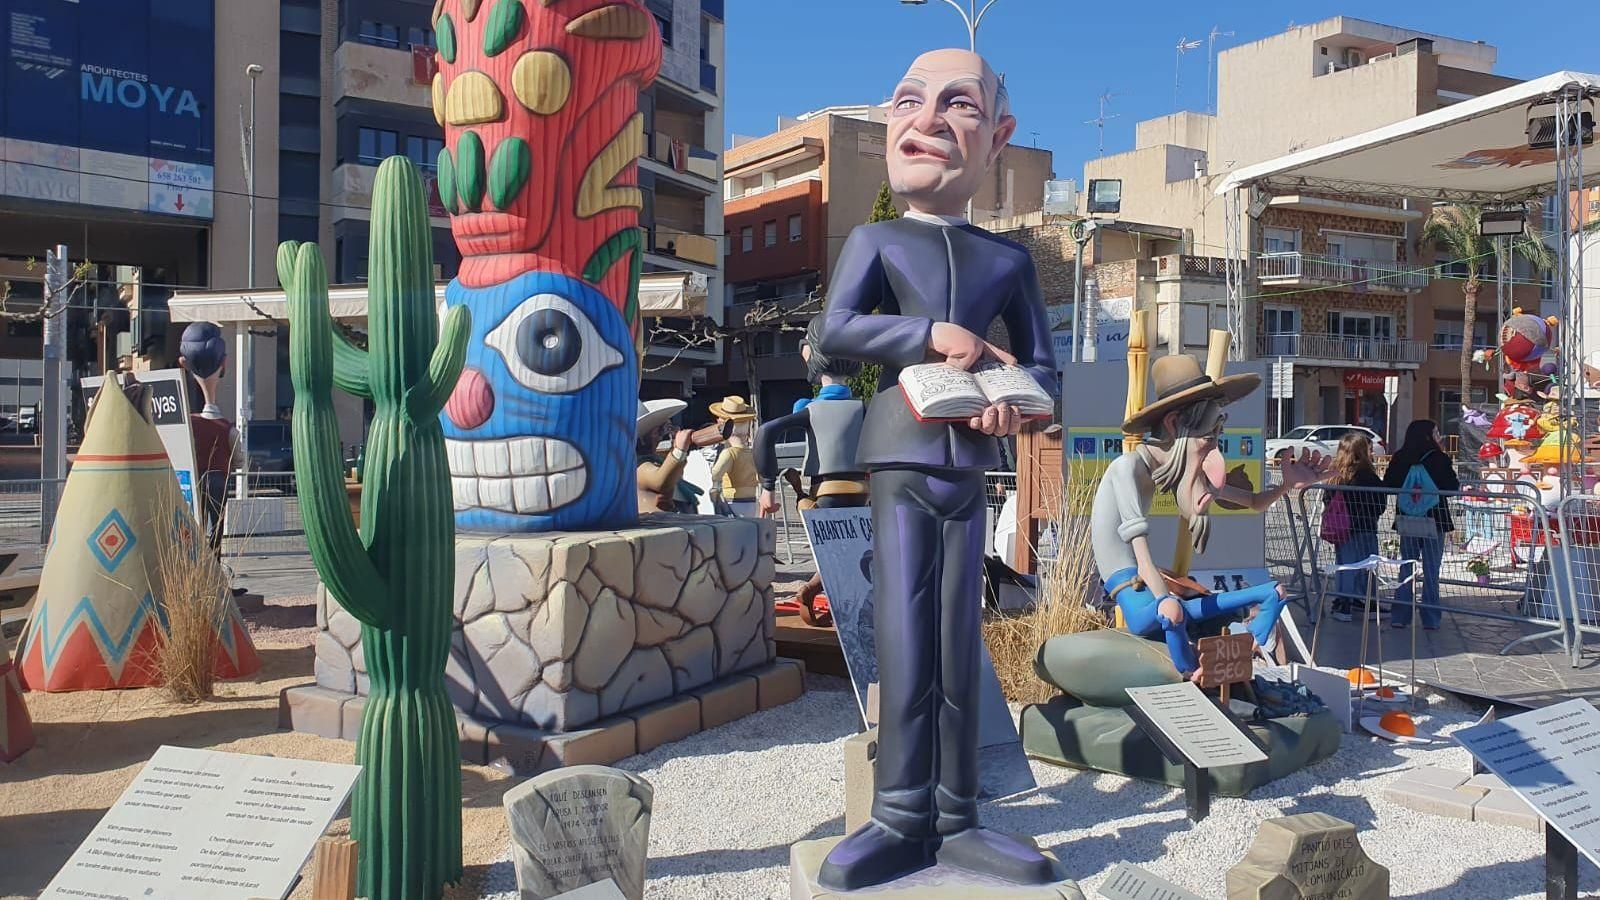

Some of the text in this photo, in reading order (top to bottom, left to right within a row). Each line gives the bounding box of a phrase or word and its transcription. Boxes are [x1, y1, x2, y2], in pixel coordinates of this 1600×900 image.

[81, 63, 148, 82] ARQUITECTES
[81, 72, 200, 118] MOYA
[1214, 638, 1240, 661] RIU
[1214, 661, 1245, 683] SEC
